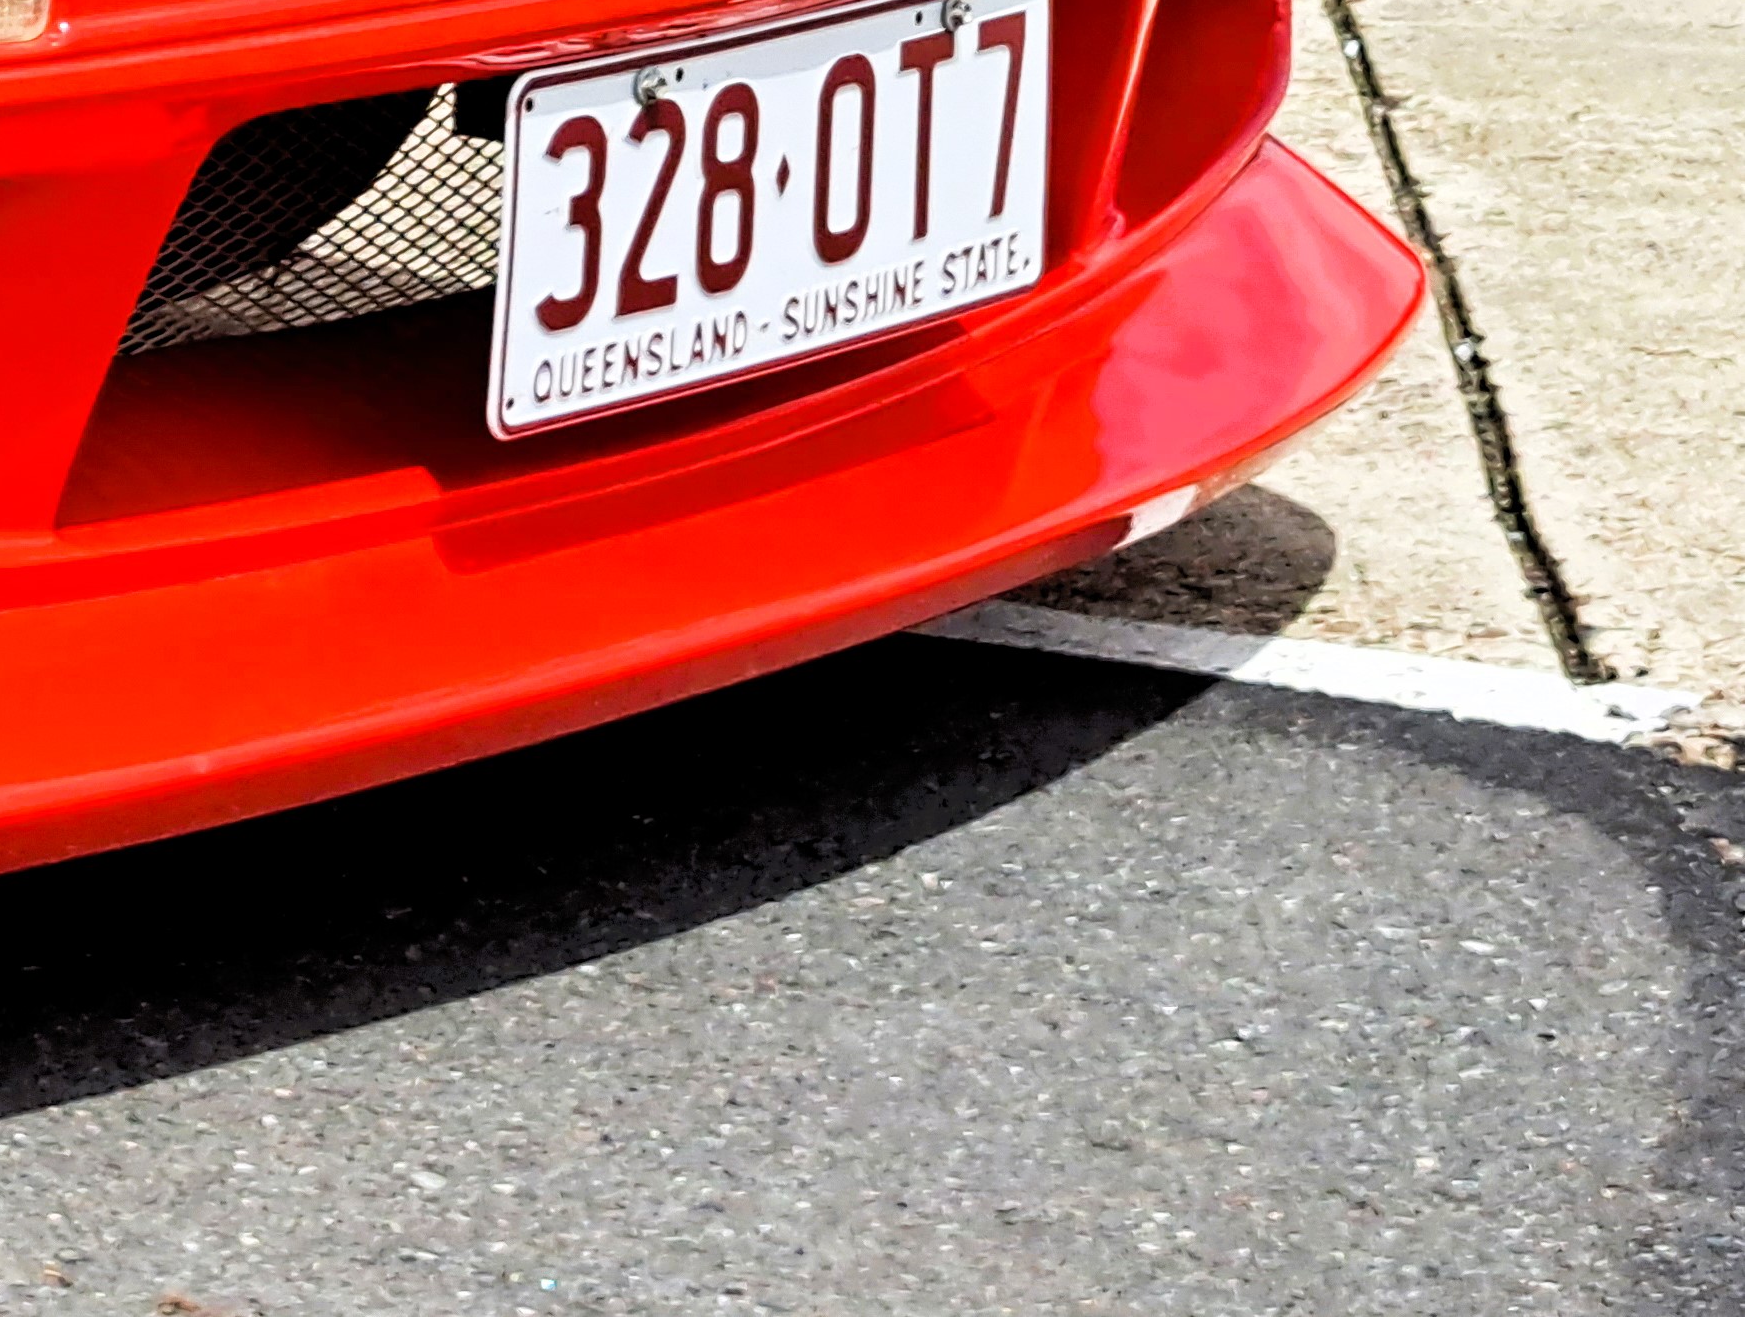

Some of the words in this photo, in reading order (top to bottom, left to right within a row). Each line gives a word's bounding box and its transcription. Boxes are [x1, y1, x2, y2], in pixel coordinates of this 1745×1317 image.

[532, 310, 748, 404] QUEENSLAND
[782, 260, 926, 342] SUNSHINE
[940, 230, 1019, 296] STATE
